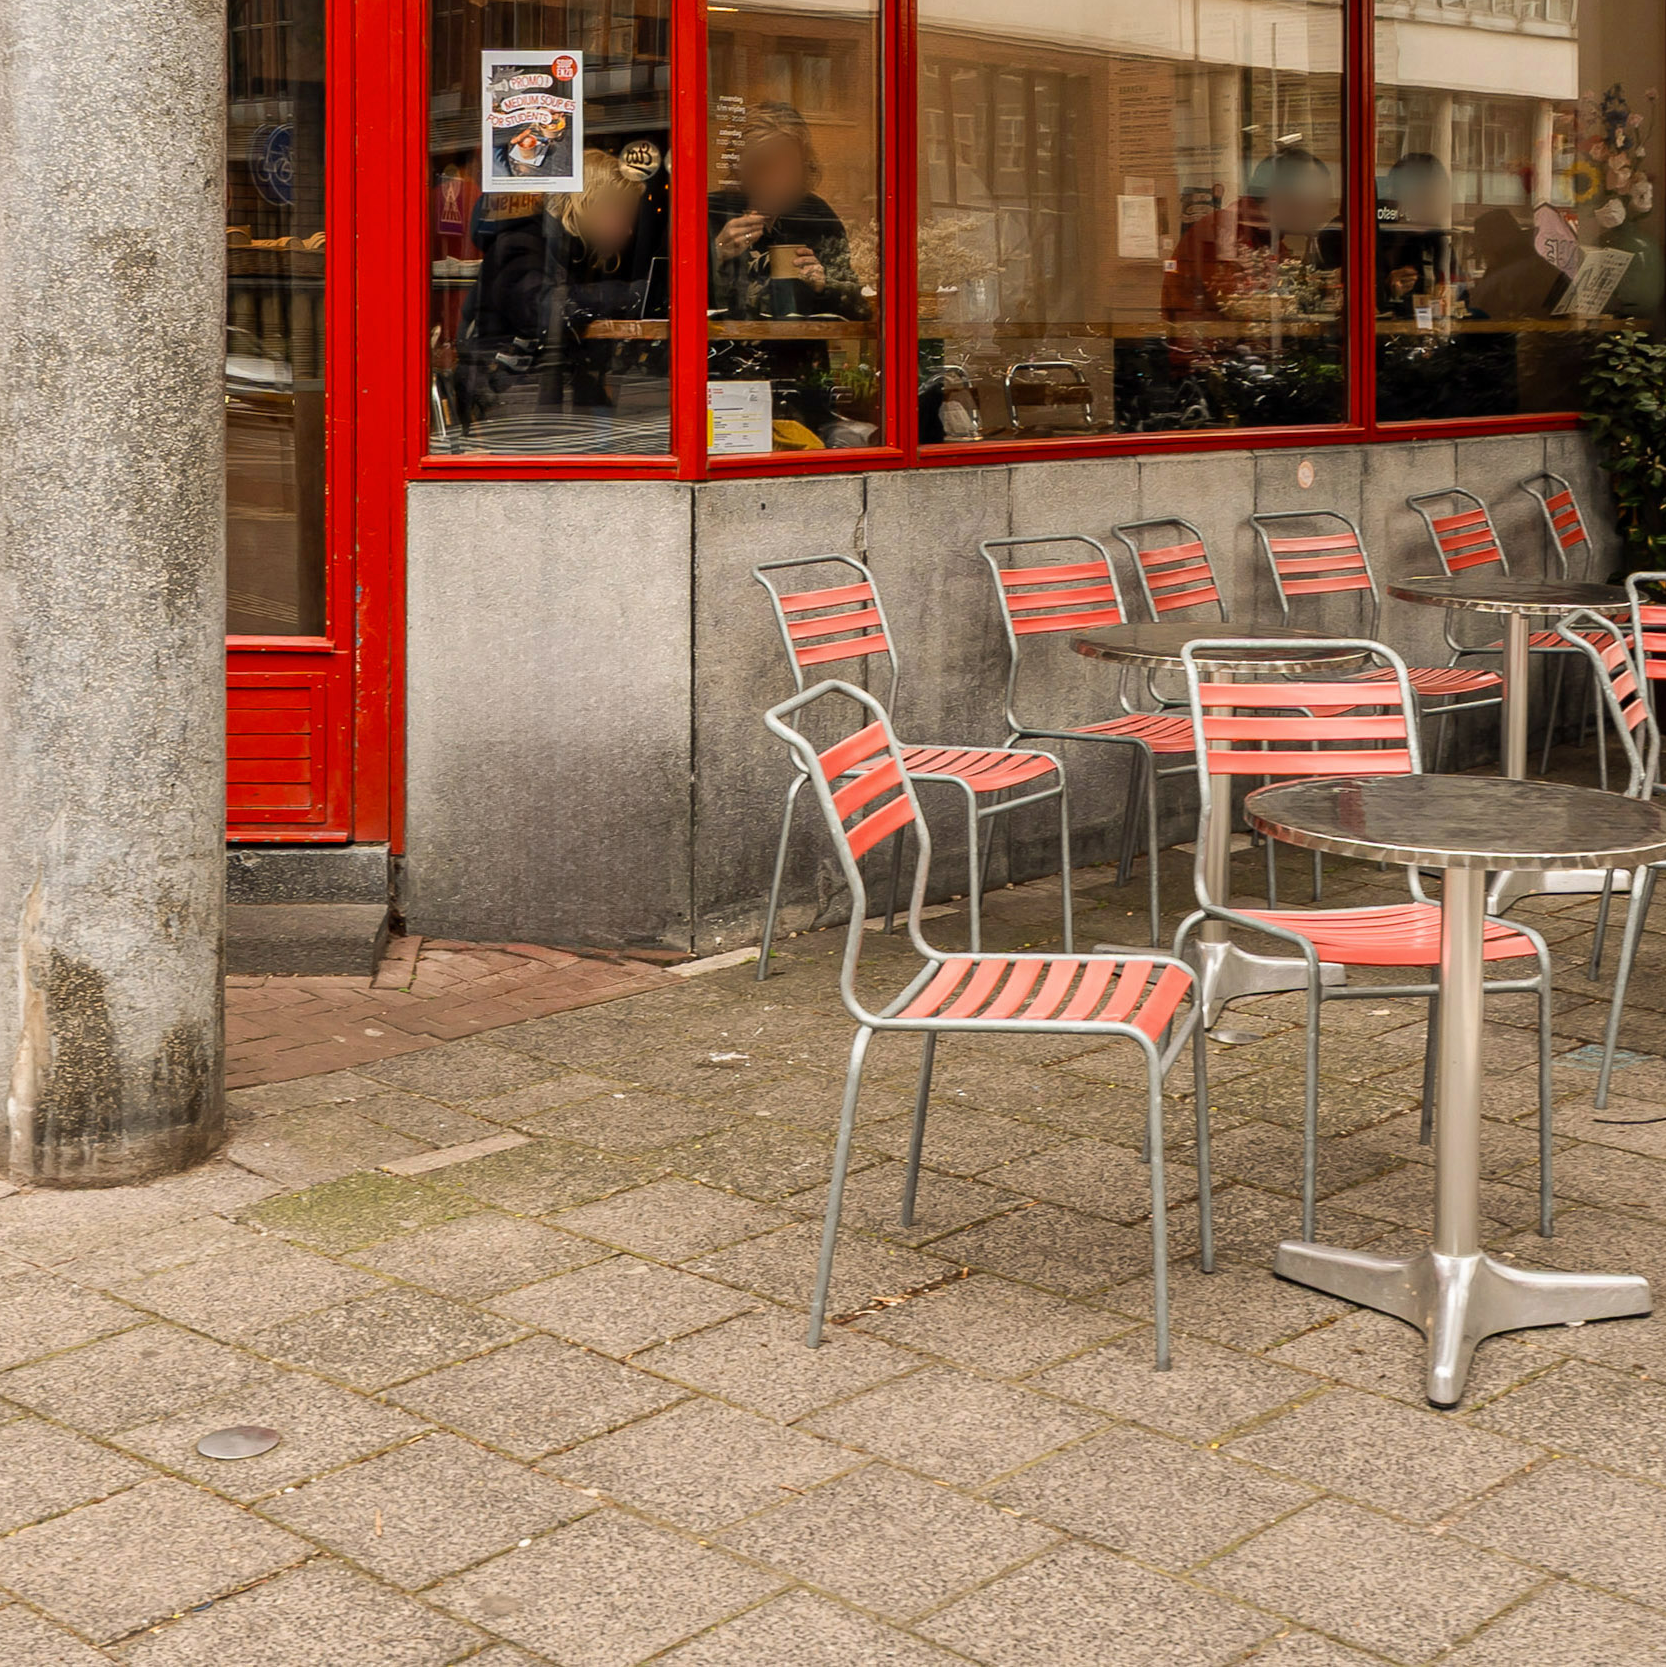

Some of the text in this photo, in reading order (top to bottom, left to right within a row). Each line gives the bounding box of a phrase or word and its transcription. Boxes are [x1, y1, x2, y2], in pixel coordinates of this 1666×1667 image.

[504, 95, 539, 111] MEDIUM
[540, 95, 564, 109] SOUP
[486, 112, 550, 127] FOR STUDENTS
